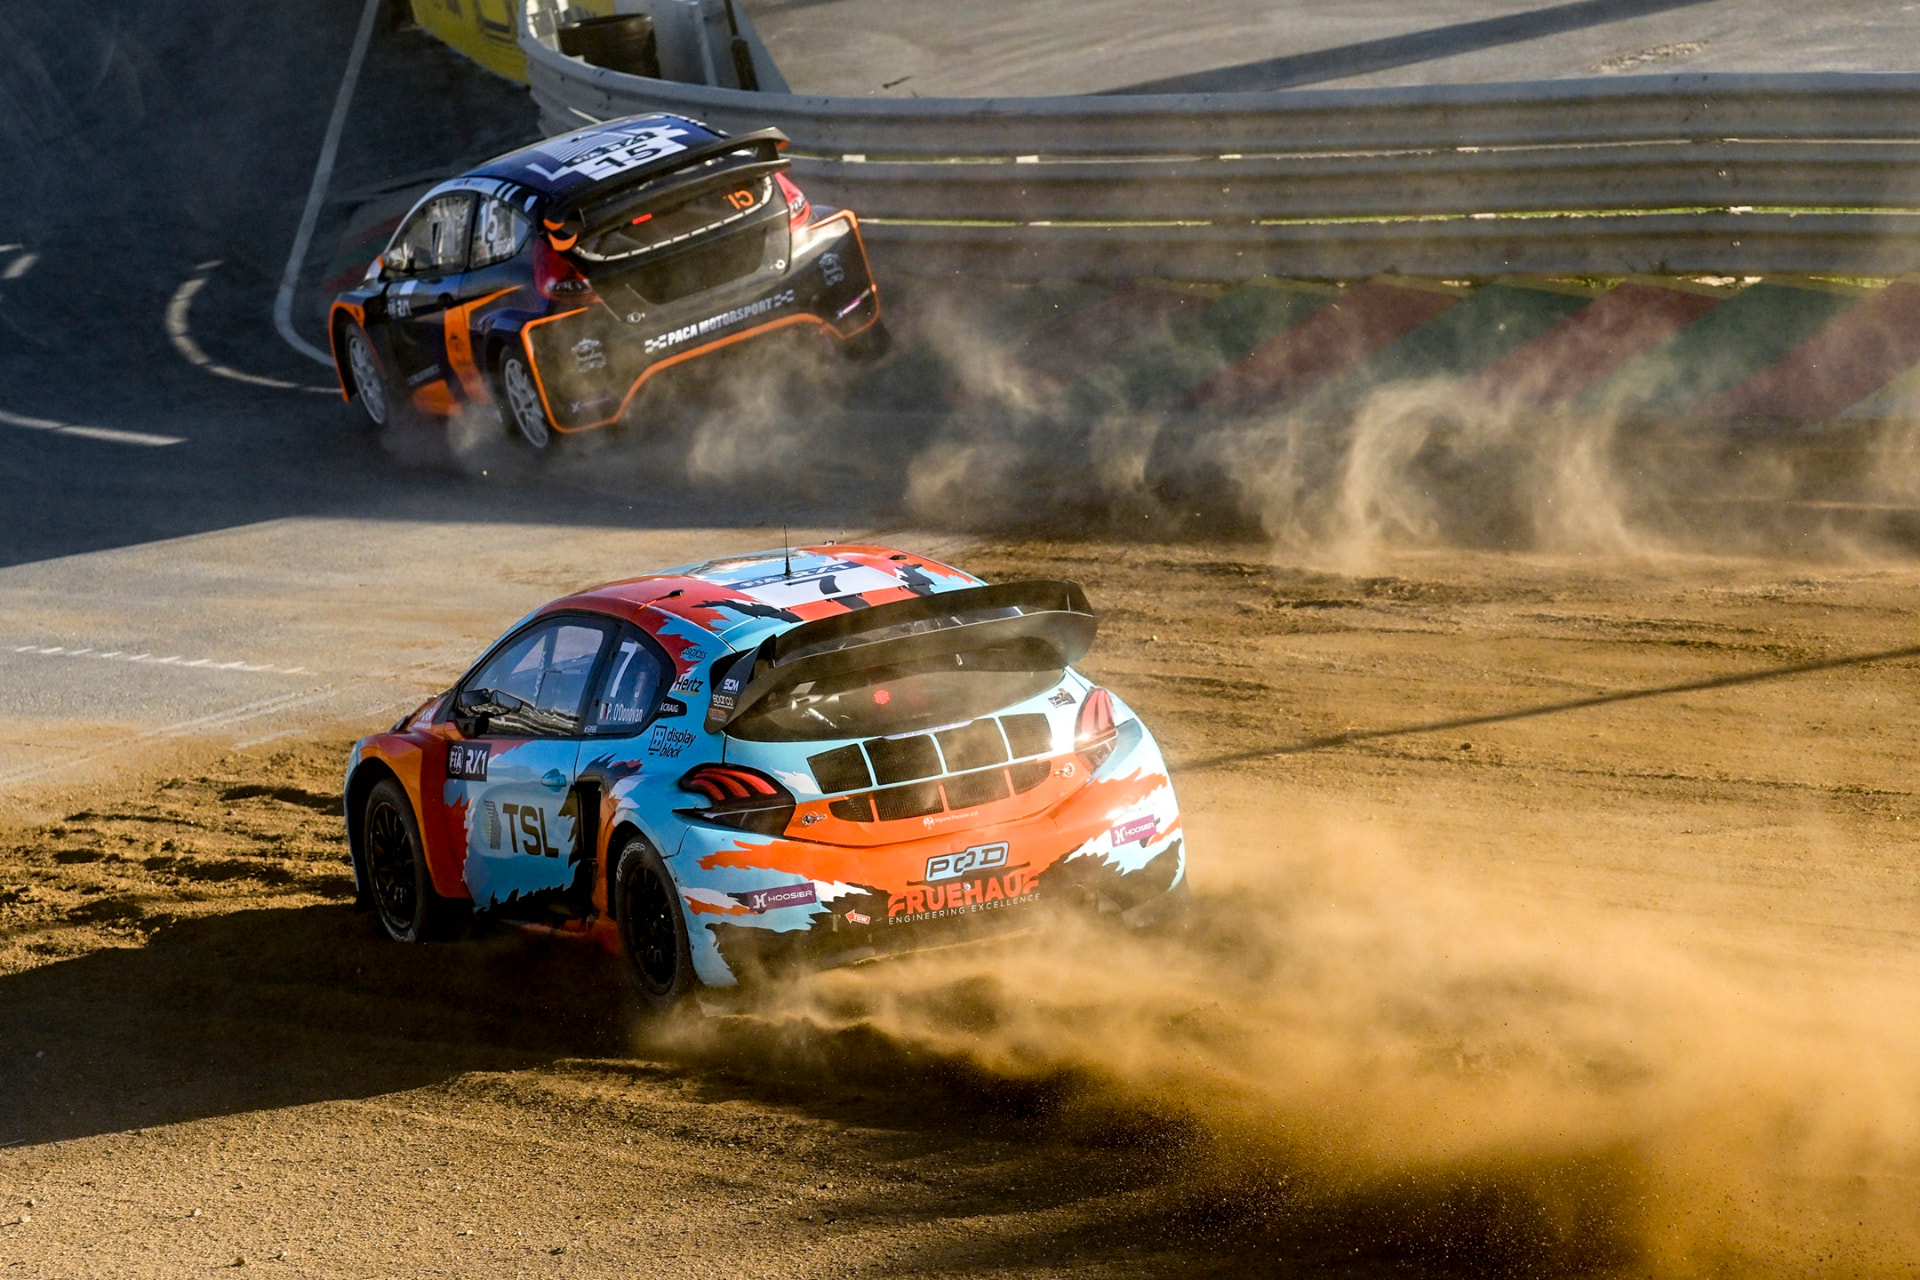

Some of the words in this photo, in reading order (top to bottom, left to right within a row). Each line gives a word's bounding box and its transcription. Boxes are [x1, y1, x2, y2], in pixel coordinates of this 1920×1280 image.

[594, 144, 662, 168] 15
[481, 200, 498, 242] 15
[667, 322, 698, 346] PACA
[699, 297, 773, 334] MOTORSPORT
[785, 574, 842, 596] 7
[609, 641, 638, 698] 7
[673, 675, 704, 693] Hertz
[723, 678, 740, 692] SCM
[712, 693, 734, 706] sparco
[613, 703, 643, 723] O'Donovan
[667, 727, 697, 748] display
[465, 749, 488, 775] RX1
[659, 743, 682, 758] block
[503, 803, 560, 859] TSL
[1125, 821, 1155, 837] HOOSIER
[929, 846, 1006, 878] POD
[768, 889, 813, 903] HOOSIER
[888, 870, 1040, 918] FRUEHAUF
[888, 907, 966, 925] ENGINEERING
[971, 893, 1041, 913] EXCELLENCE
